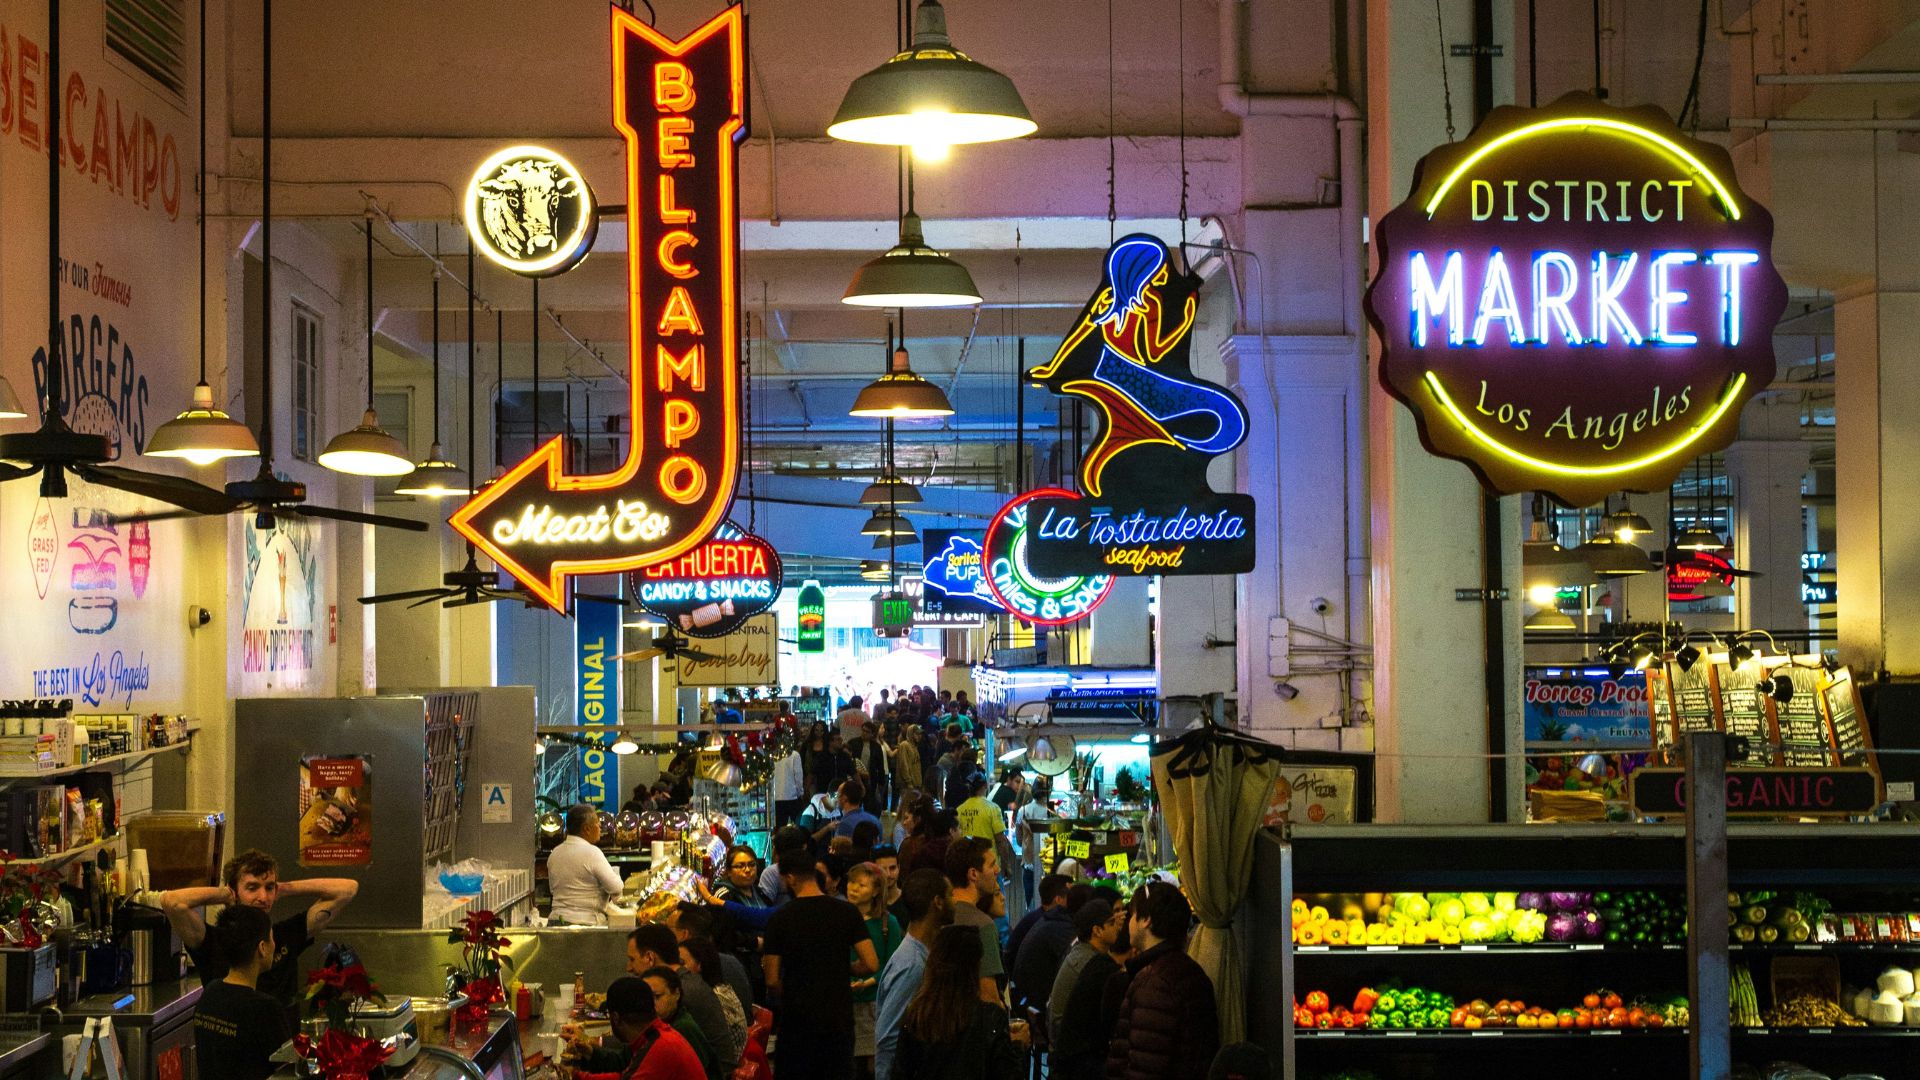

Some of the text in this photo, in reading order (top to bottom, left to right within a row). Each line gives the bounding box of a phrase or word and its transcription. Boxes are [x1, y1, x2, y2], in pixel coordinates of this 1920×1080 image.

[1470, 179, 1693, 223] DISTRICT
[71, 263, 89, 291] OUR
[92, 261, 131, 308] Famous
[654, 61, 706, 504] BELCAMPO
[1409, 249, 1760, 348] MARKET
[1475, 380, 1692, 450] Los Angeles
[493, 503, 610, 544] Meat
[1038, 507, 1079, 540] La
[33, 537, 54, 552] GRASS
[681, 544, 767, 577] HUERTA
[1104, 544, 1186, 574] seafood
[37, 557, 49, 573] FED
[641, 578, 771, 601] CANDY & SNACKS
[991, 557, 1037, 615] Chiles
[1041, 597, 1062, 619] &
[883, 600, 909, 625] EXIT
[927, 601, 942, 611] E-5
[243, 629, 267, 672] CANDY
[33, 650, 150, 711] THE BEST IN Los Angeles
[1526, 679, 1595, 706] Torres
[488, 785, 505, 804] A
[1673, 775, 1836, 808] OGANIC
